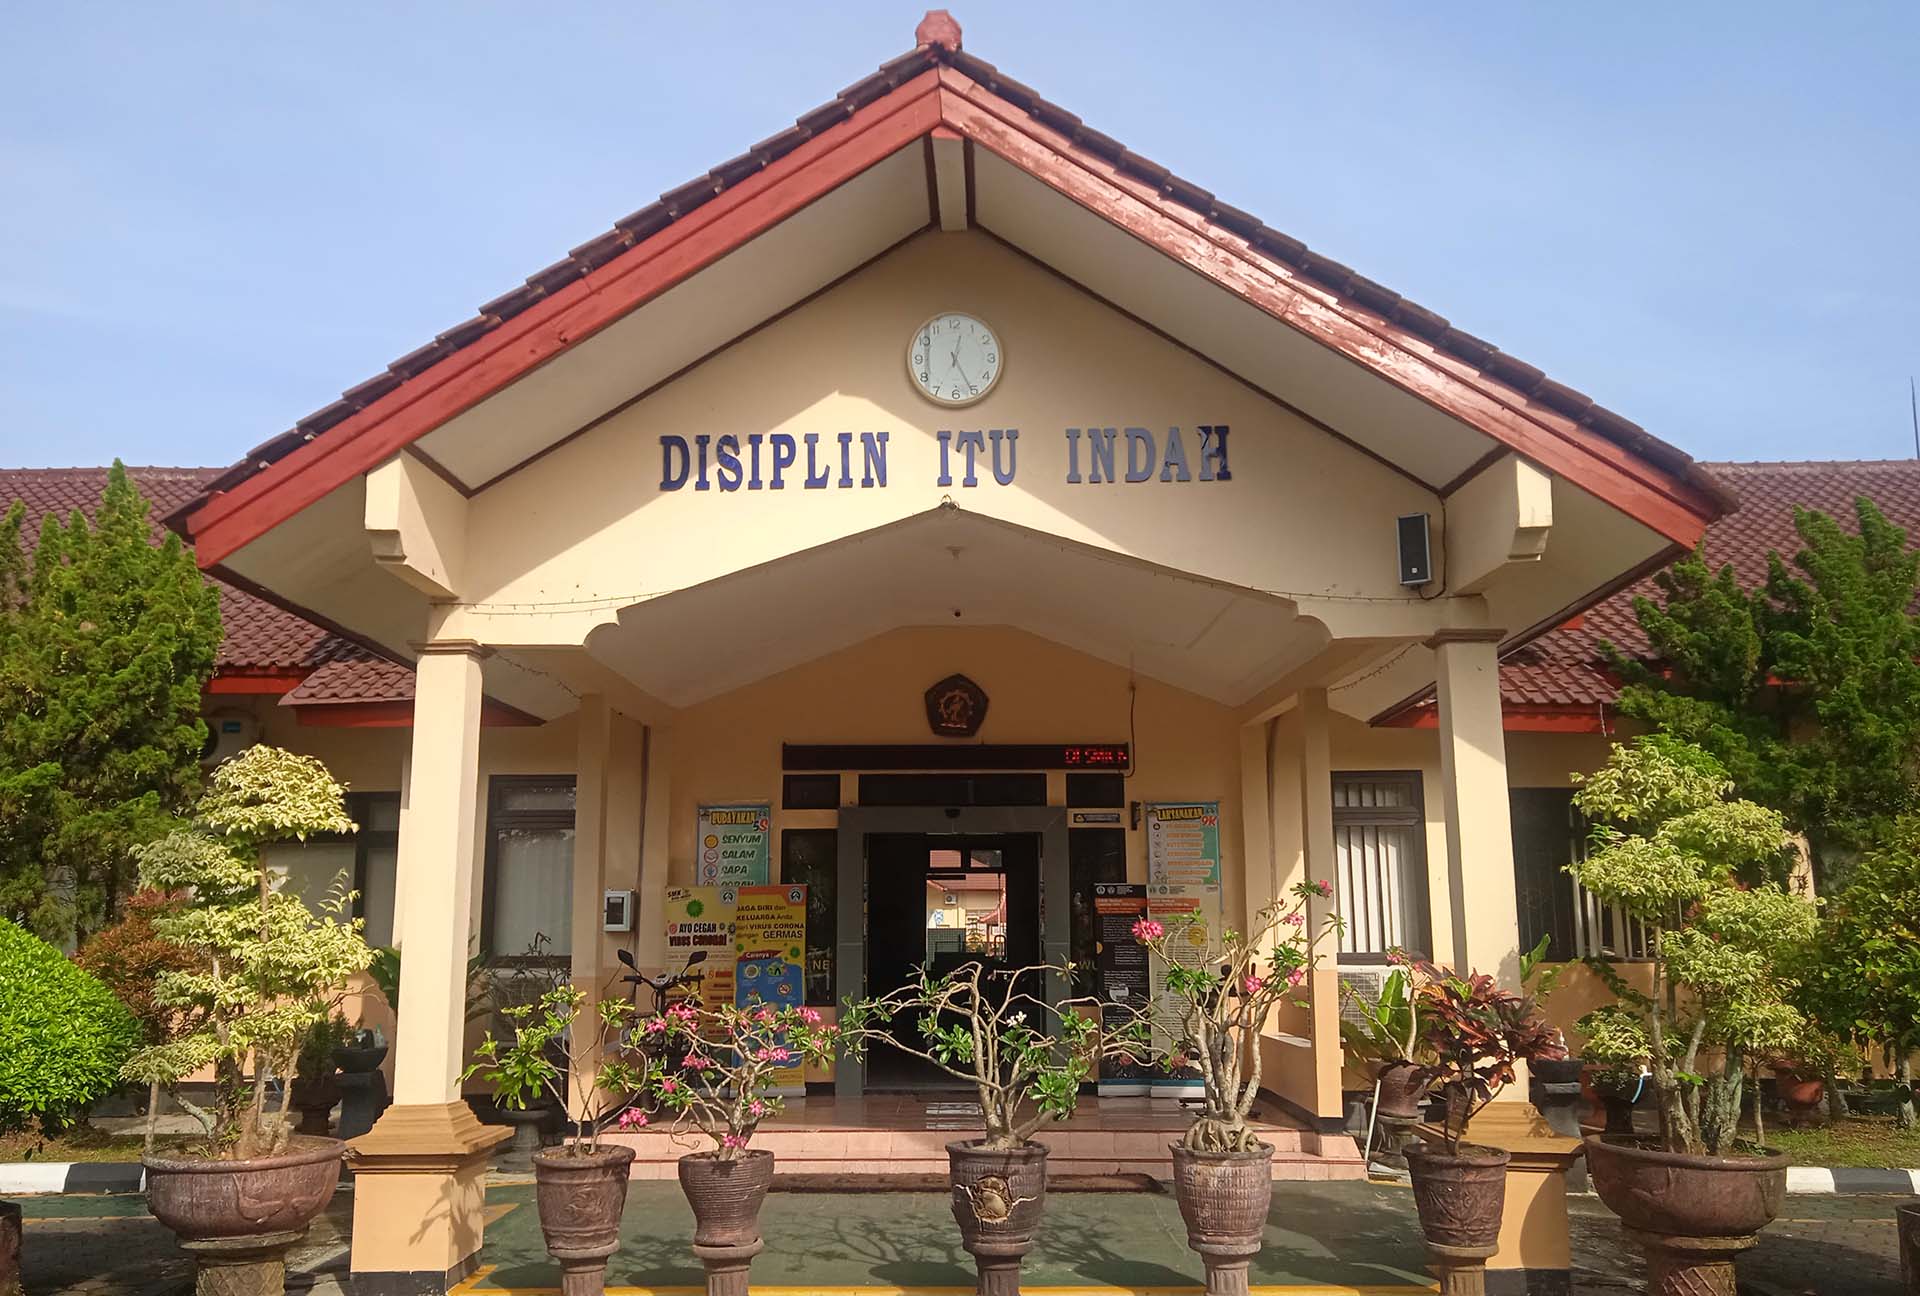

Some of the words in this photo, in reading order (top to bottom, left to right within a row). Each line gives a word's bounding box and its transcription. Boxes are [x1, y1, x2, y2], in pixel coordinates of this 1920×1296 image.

[932, 324, 940, 336] 11
[949, 319, 961, 330] 12
[970, 324, 974, 334] 1
[919, 335, 931, 347] 10
[982, 335, 990, 345] 2
[914, 354, 923, 365] 9
[987, 353, 996, 363] 3
[920, 372, 928, 382] 8
[982, 371, 991, 382] 4
[932, 386, 940, 396] 7
[951, 389, 960, 400] 6
[970, 384, 979, 396] 5
[660, 432, 889, 492] DISIPLIN
[937, 429, 1019, 487] ITU
[1066, 426, 1232, 483] INDAH
[753, 819, 769, 832] 5S
[721, 834, 762, 845] SENYUM
[721, 849, 756, 859] SALAM
[721, 865, 748, 874] SAPA
[679, 923, 693, 933] AYO
[693, 922, 717, 933] CEGAH
[763, 930, 803, 940] GERMAS
